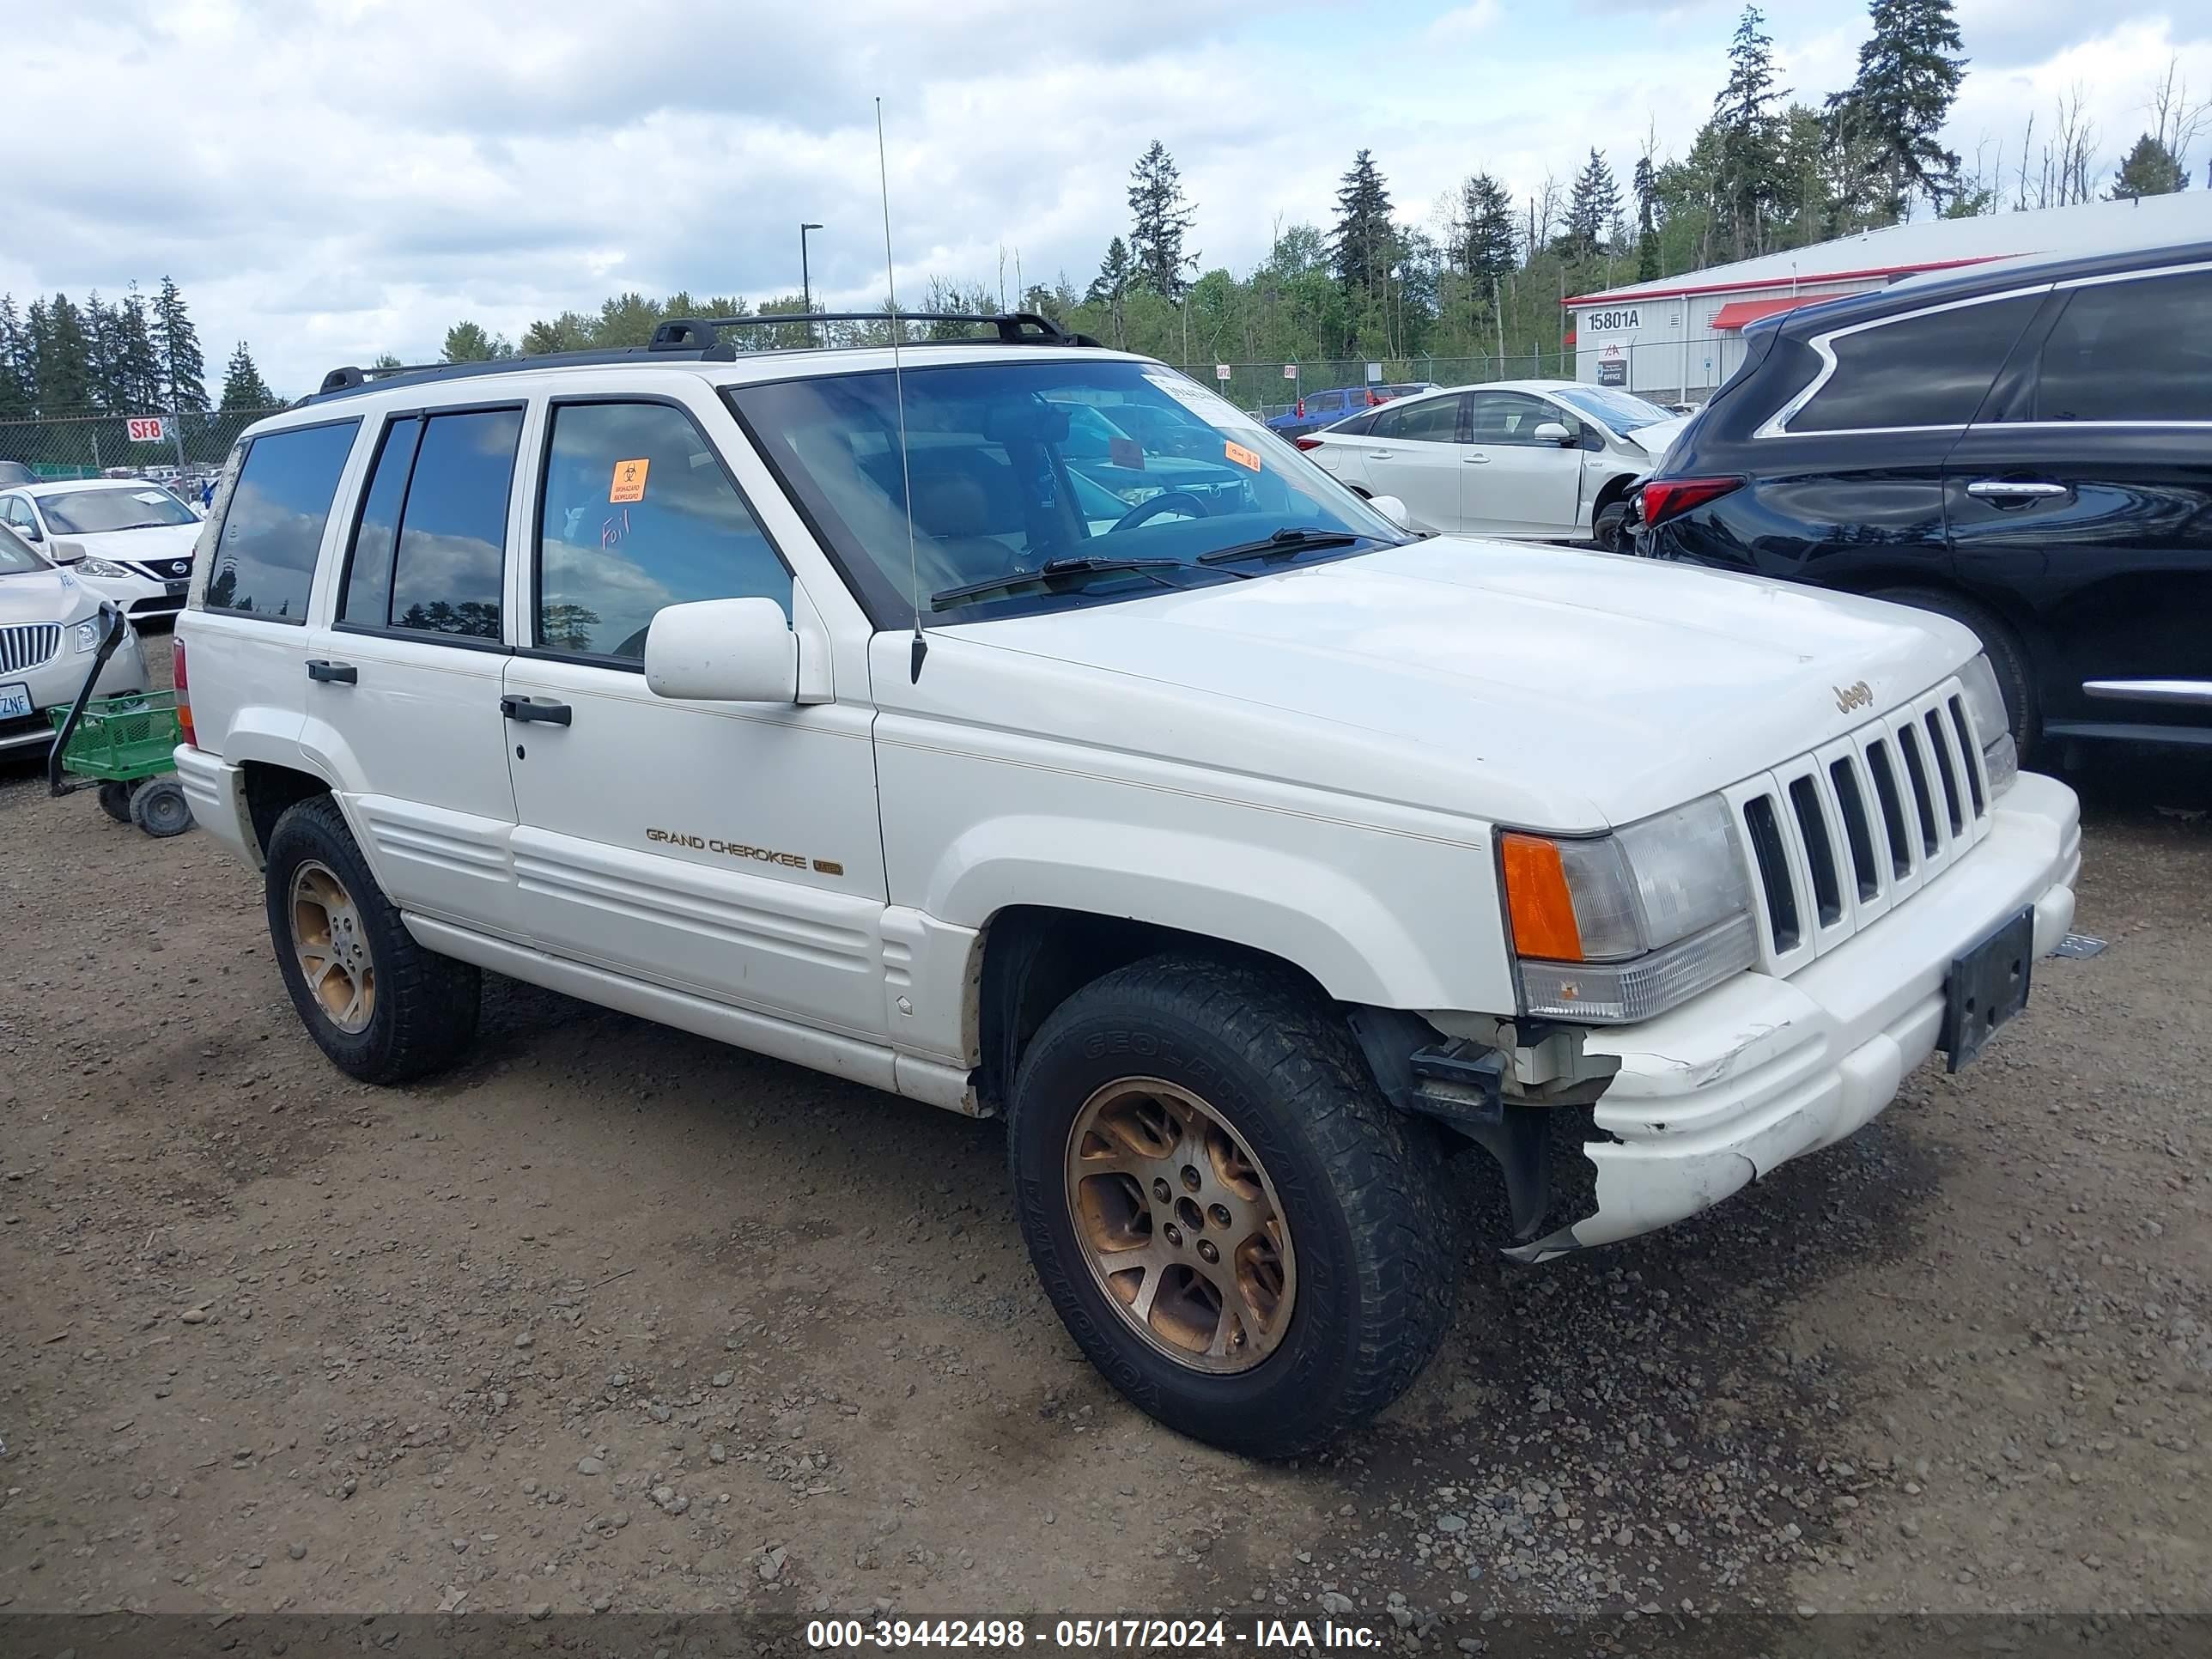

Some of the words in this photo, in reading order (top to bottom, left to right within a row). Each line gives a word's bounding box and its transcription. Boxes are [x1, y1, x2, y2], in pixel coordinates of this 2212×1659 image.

[1588, 310, 1639, 331] 15801A
[131, 421, 161, 439] SF8
[1832, 680, 1873, 714] Jeep
[646, 829, 705, 849] GRAND
[708, 840, 807, 870] CHEROKEE
